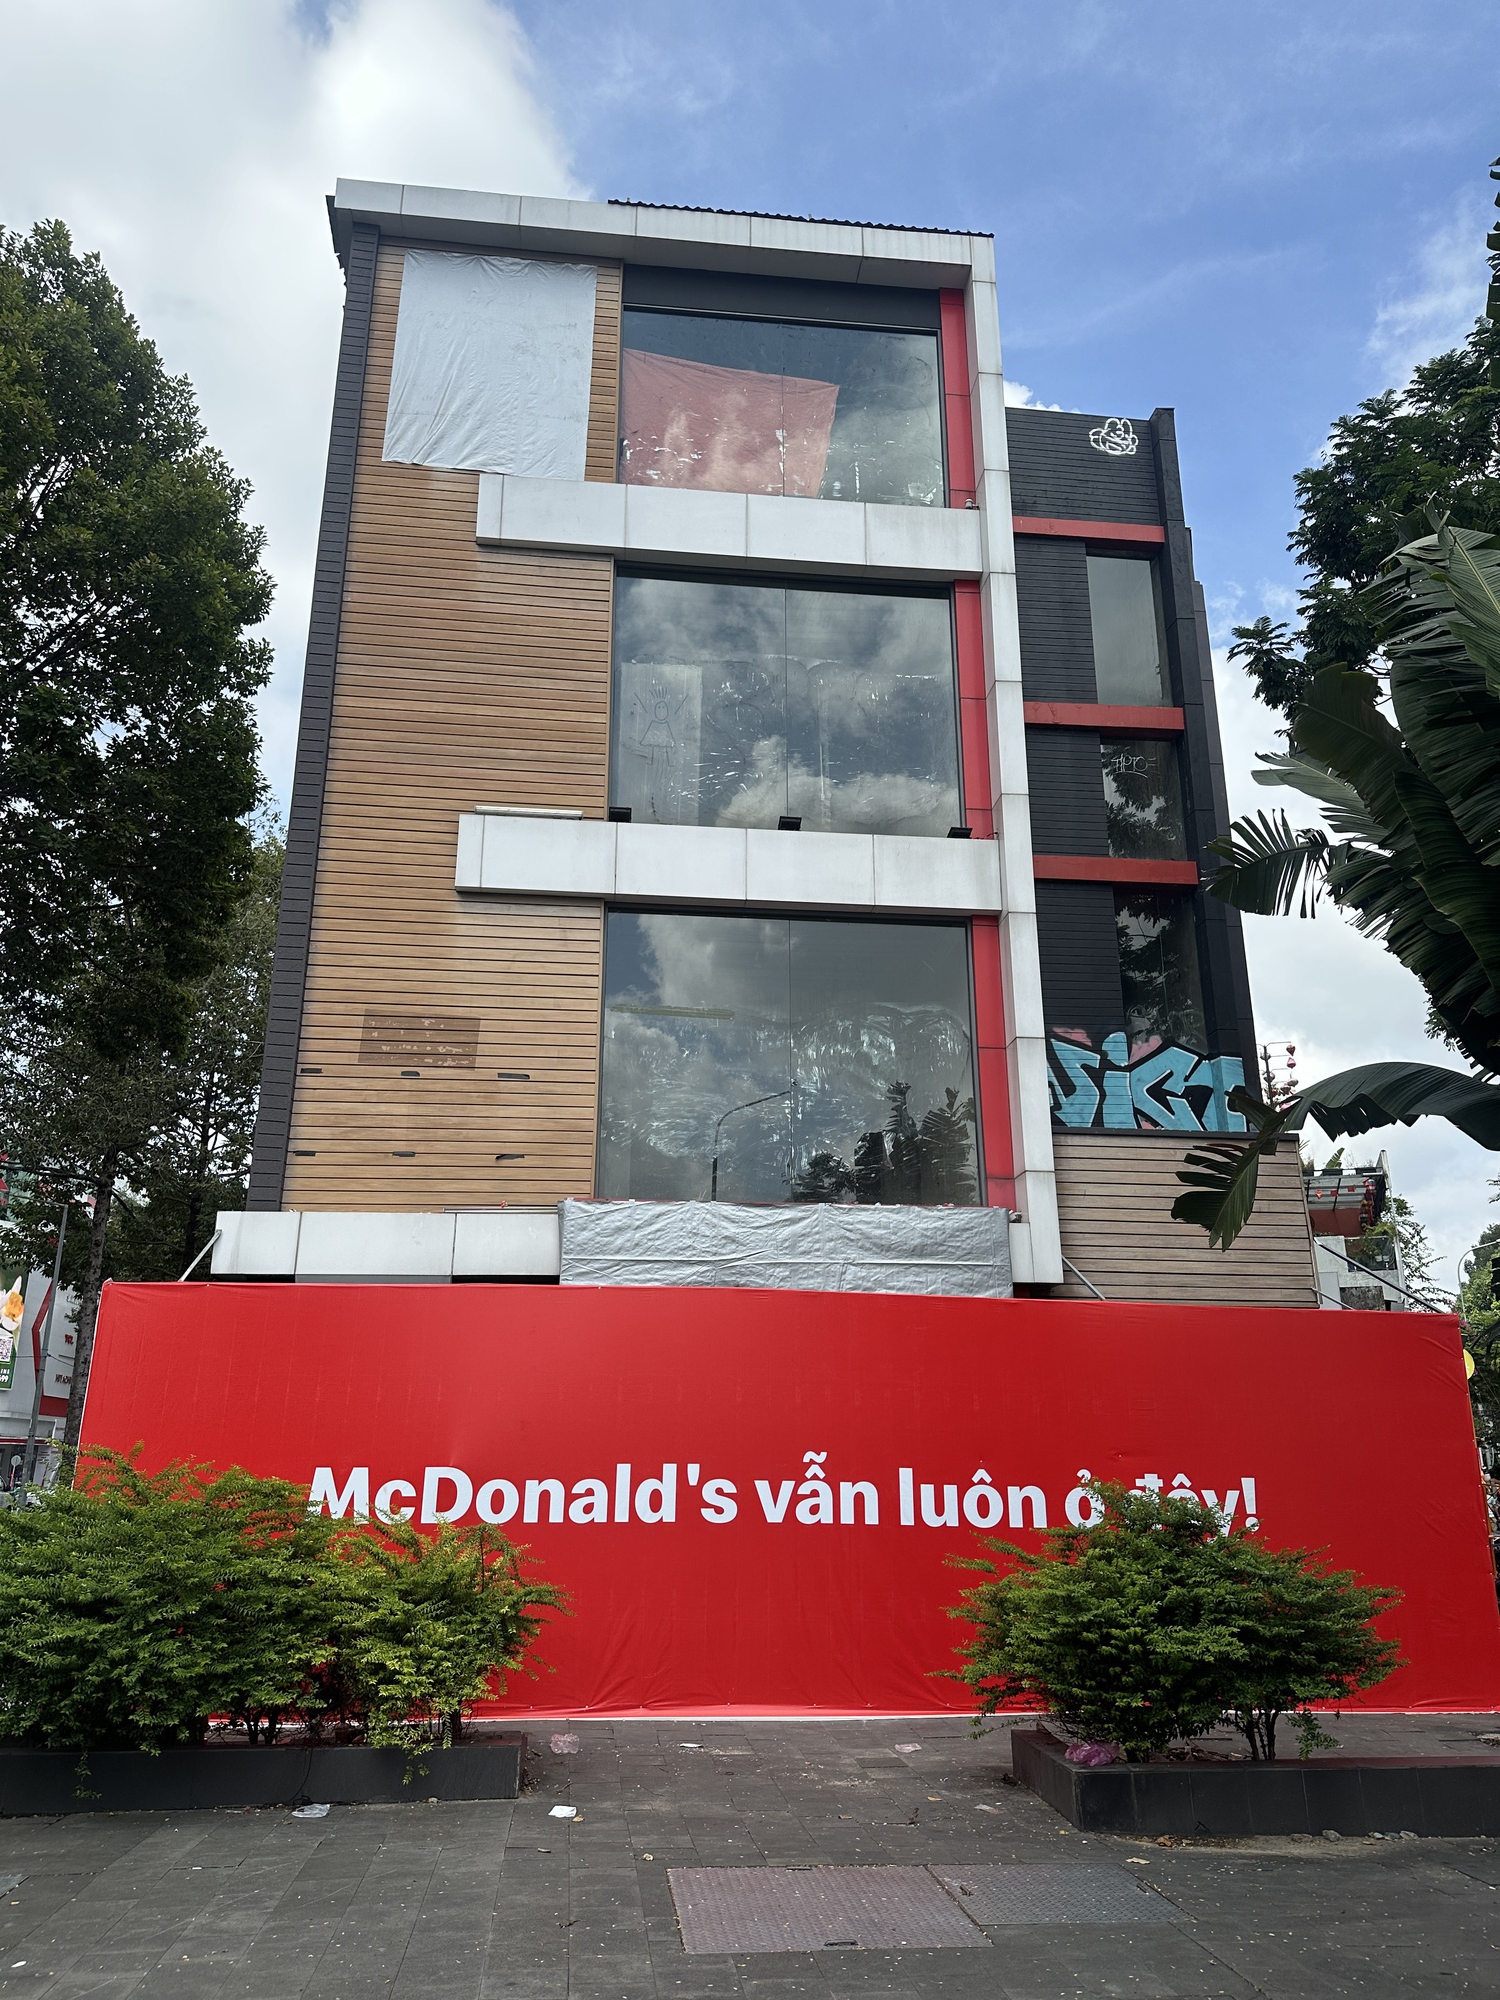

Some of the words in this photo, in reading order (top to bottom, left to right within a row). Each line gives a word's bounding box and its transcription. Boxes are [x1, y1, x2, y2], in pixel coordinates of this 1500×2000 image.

[307, 1463, 738, 1526] McDonald's
[755, 1451, 879, 1525] vẫn
[899, 1467, 1048, 1529] luôn
